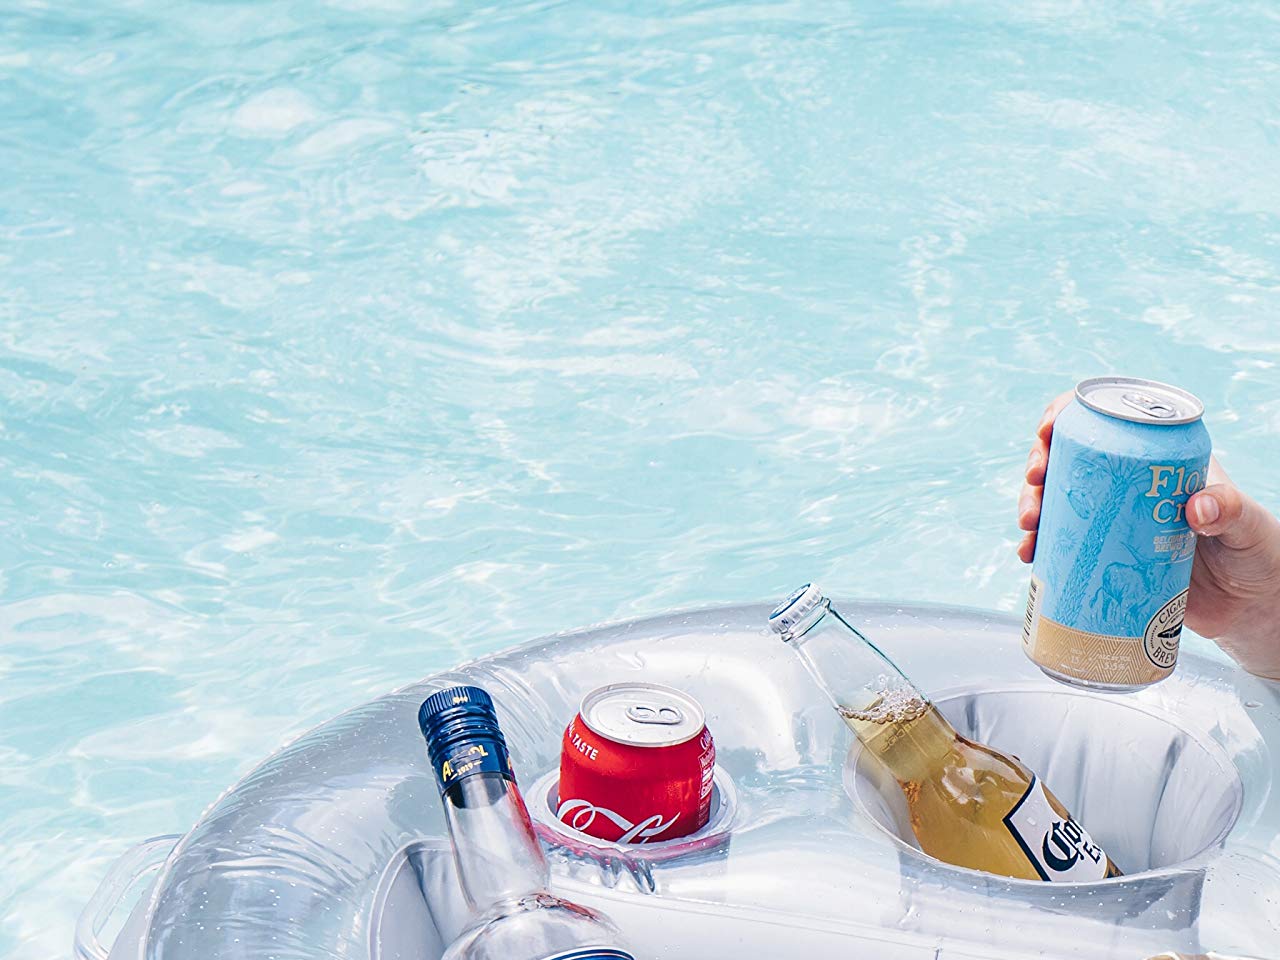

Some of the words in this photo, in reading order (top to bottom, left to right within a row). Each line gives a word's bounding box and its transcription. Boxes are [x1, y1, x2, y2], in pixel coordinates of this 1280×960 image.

[1145, 464, 1206, 496] Flo
[1153, 499, 1186, 524] Cr
[572, 733, 599, 761] TASTE
